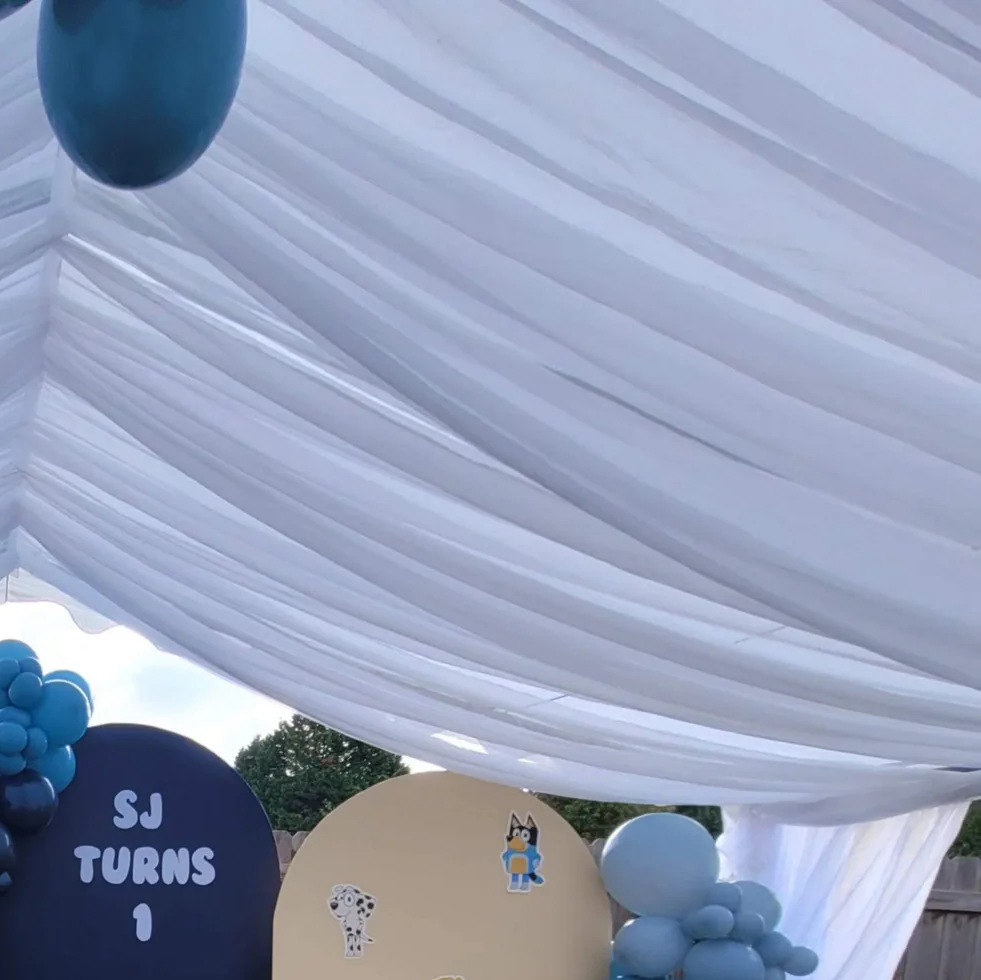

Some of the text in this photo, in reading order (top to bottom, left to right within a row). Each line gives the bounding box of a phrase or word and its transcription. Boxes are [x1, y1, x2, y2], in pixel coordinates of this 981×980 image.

[112, 789, 163, 830] SJ
[73, 845, 216, 886] TURNS
[132, 902, 153, 942] 1
